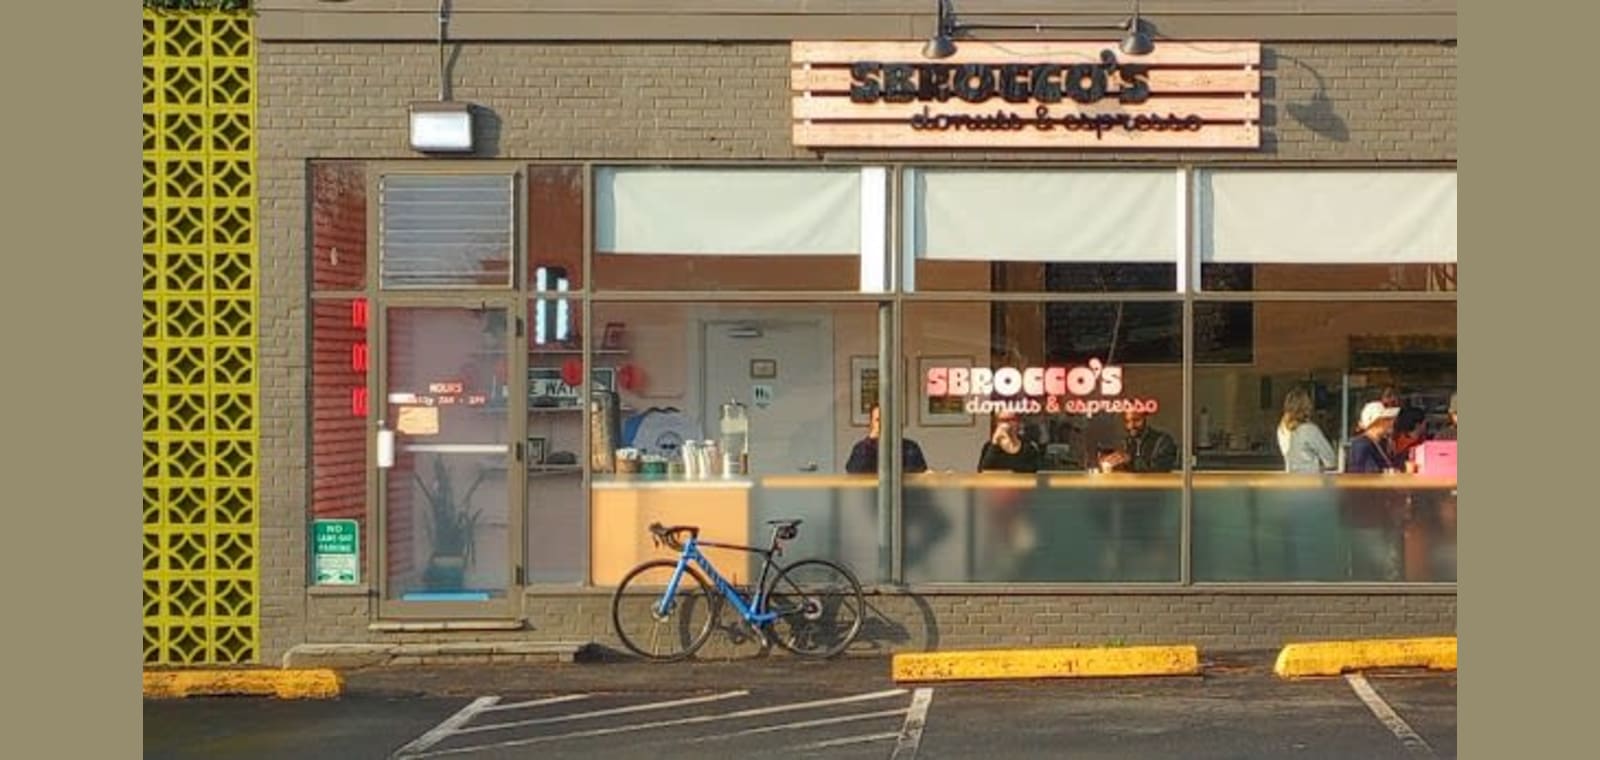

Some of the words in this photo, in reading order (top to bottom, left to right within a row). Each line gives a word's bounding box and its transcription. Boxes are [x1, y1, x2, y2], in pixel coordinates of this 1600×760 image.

[850, 50, 1150, 104] SBROCCO'S
[910, 106, 1023, 133] donuts
[1034, 106, 1055, 132] &
[1063, 111, 1203, 138] espresso
[927, 358, 1122, 395] SBROCCO'S
[965, 396, 1042, 415] donuts
[1045, 396, 1060, 413] &
[1065, 400, 1158, 419] espresso
